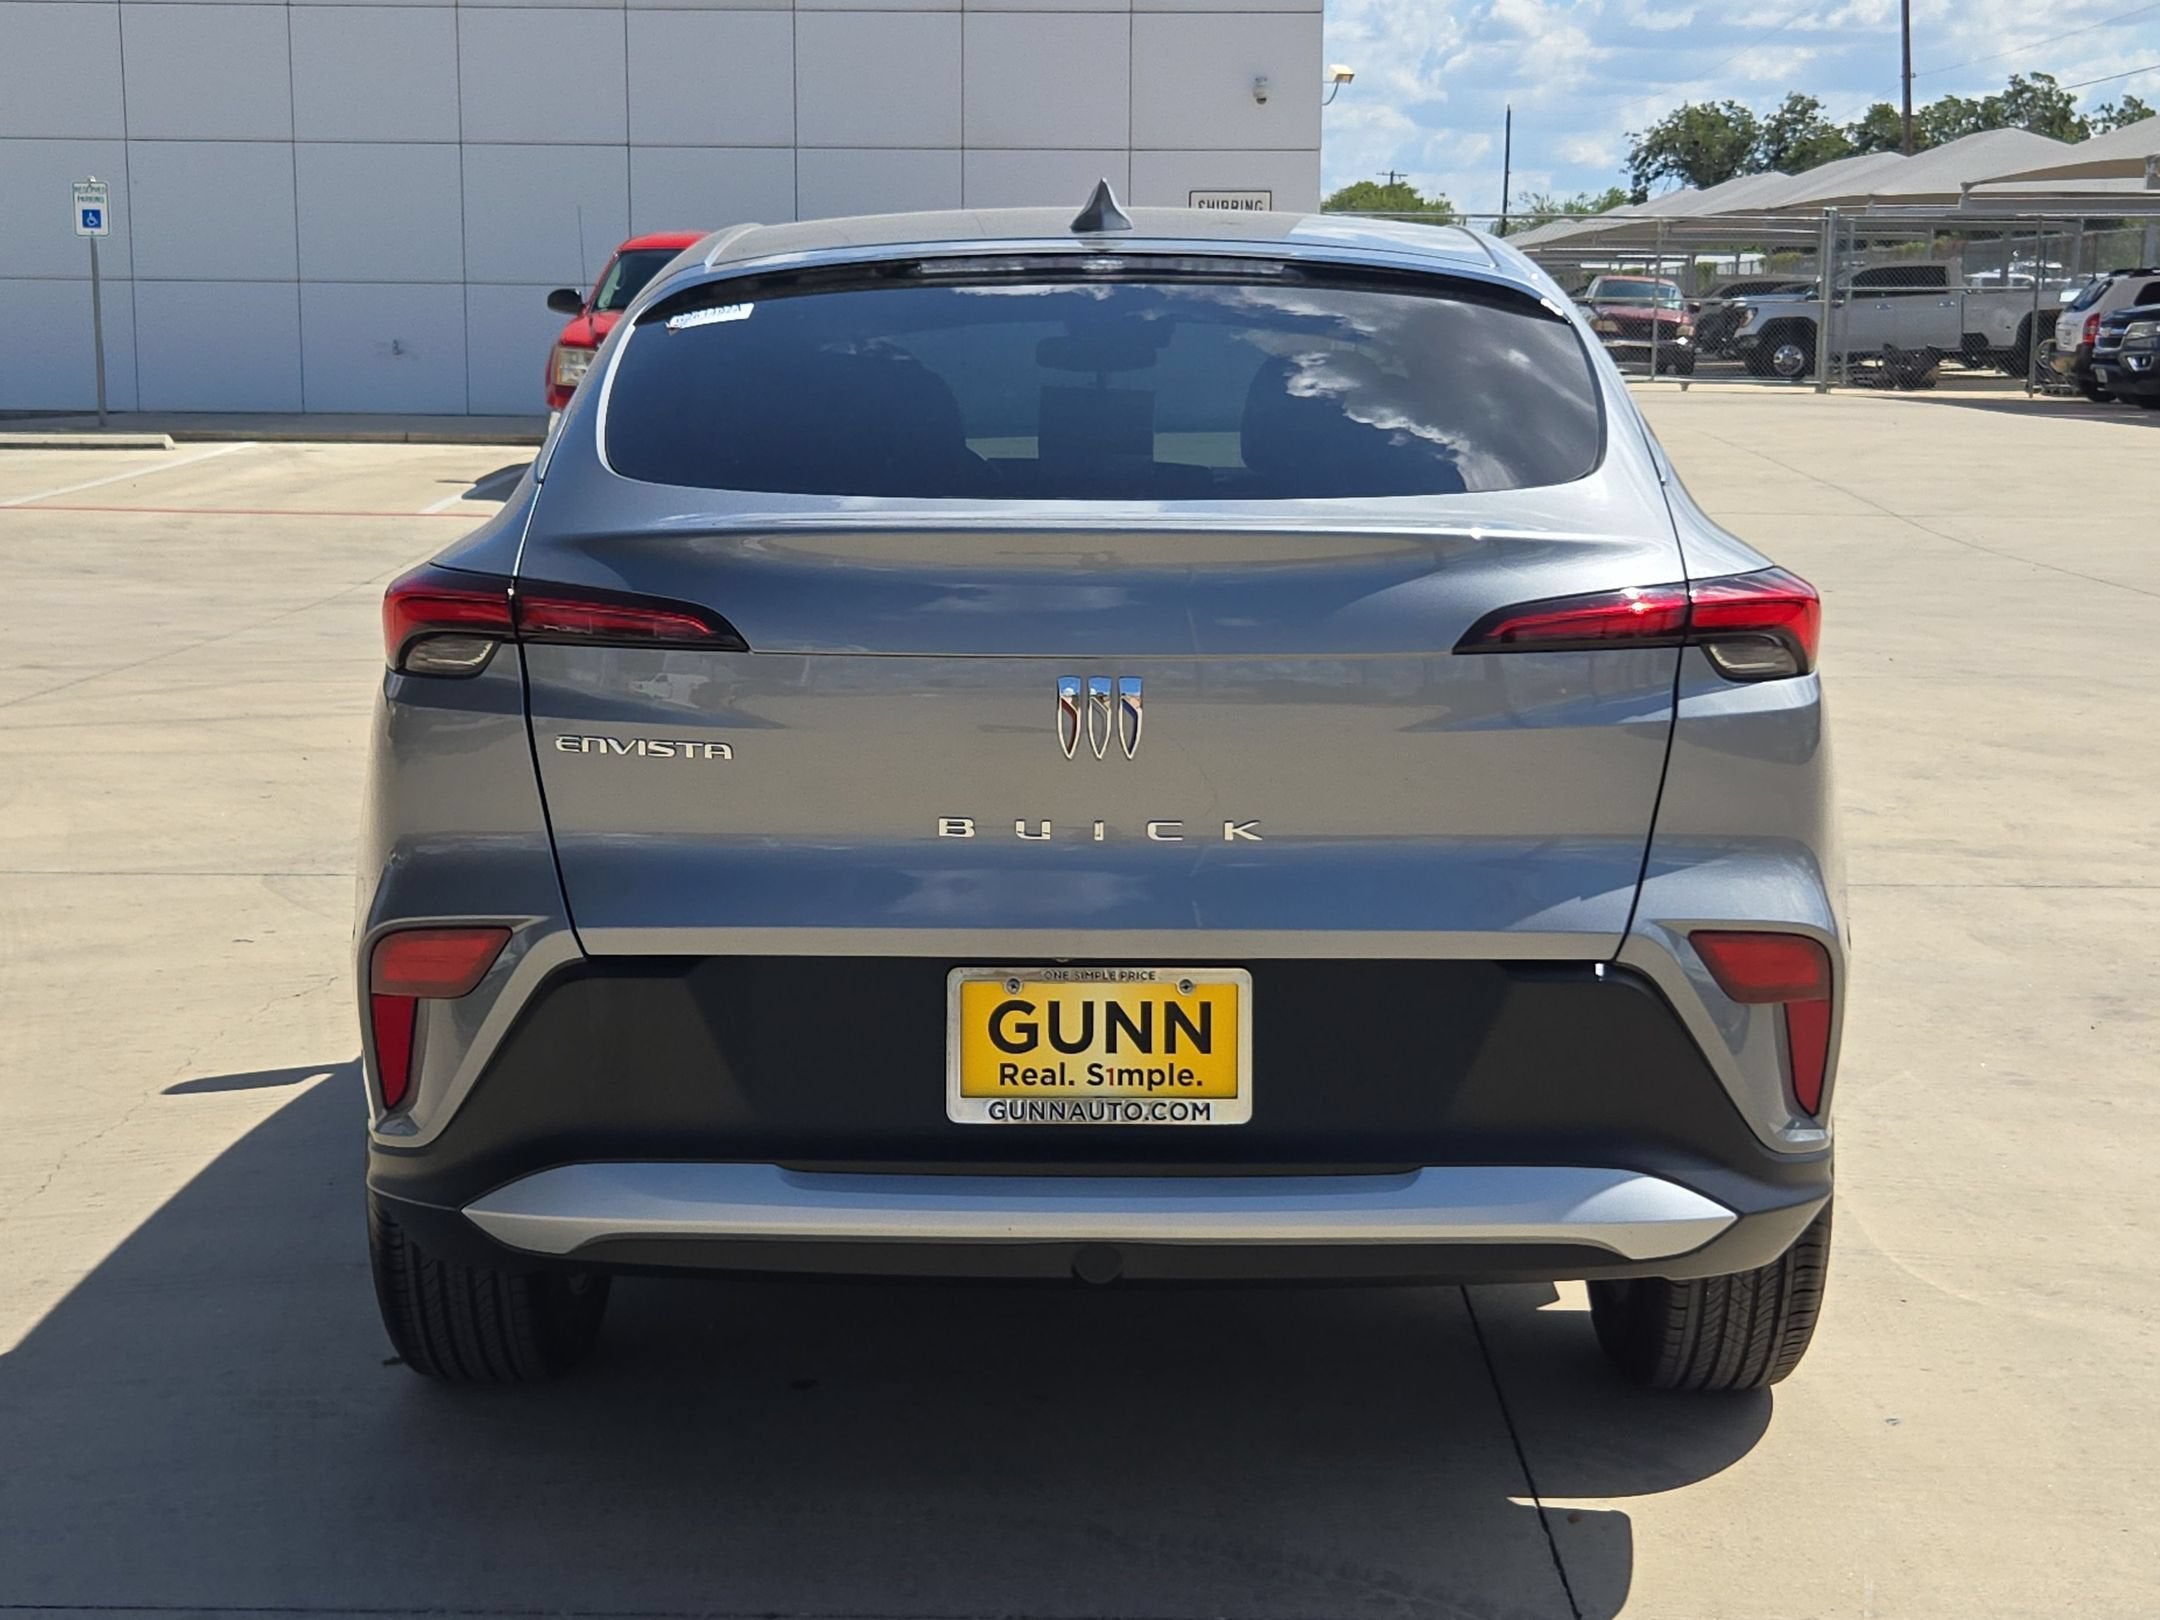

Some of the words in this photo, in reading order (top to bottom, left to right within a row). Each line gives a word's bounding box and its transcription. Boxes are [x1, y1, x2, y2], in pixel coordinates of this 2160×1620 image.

[555, 735, 733, 760] ENVISTA
[938, 817, 1262, 841] BUICK
[1044, 970, 1069, 980] ONE
[1074, 970, 1116, 981] SIMPLE
[1120, 970, 1156, 981] PRICE
[988, 1000, 1212, 1054] GUNN
[999, 1062, 1075, 1086] Real.
[988, 1102, 1211, 1121] GUNNAUTO.COM
